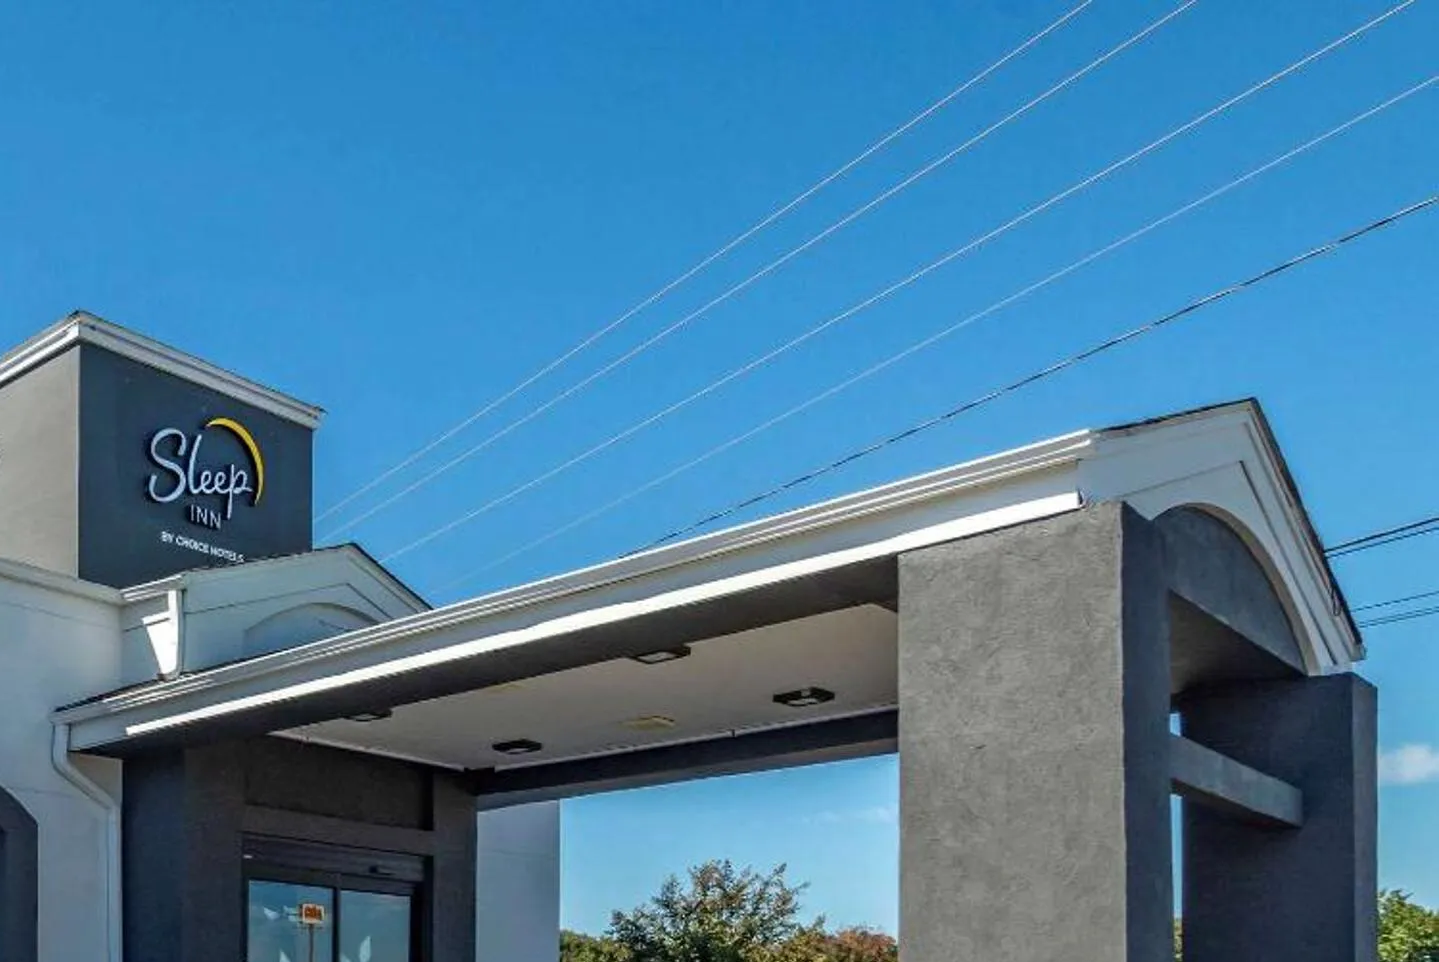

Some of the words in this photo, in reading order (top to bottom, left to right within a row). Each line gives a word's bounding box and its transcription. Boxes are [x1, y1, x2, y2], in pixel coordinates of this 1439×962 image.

[148, 427, 253, 520] Sleep
[190, 504, 222, 529] INN
[161, 530, 174, 542] BY
[176, 535, 210, 554] CHOICE
[210, 545, 245, 563] HOTELS
